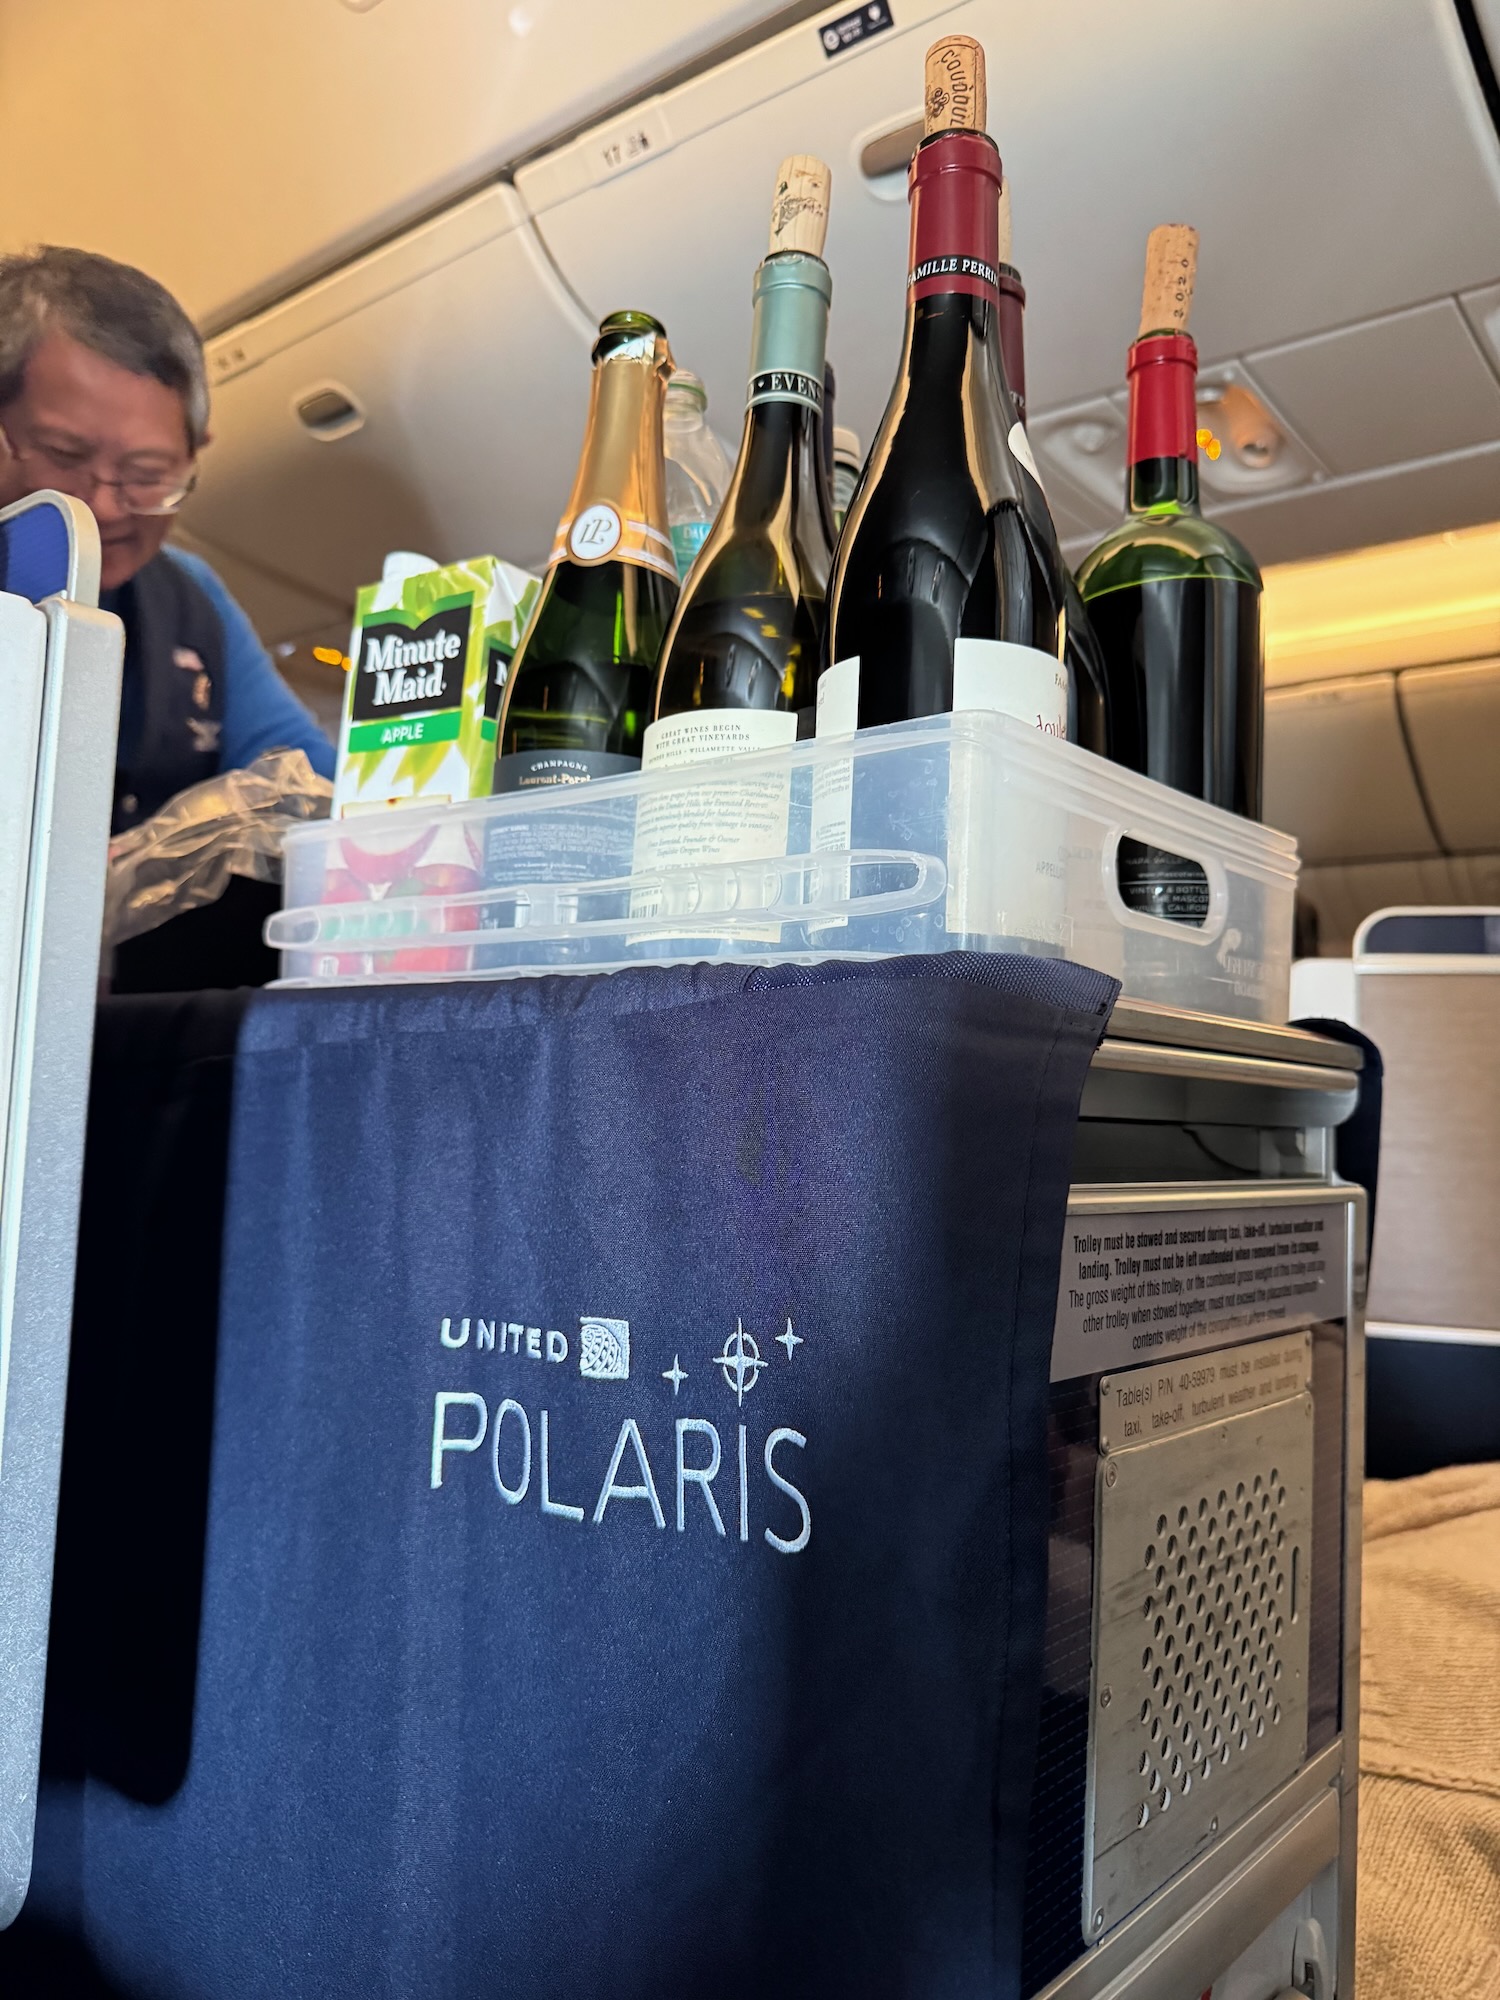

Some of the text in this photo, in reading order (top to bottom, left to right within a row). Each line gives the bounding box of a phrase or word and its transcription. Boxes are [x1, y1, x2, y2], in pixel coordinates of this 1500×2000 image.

[364, 629, 461, 673] Minute
[381, 722, 424, 744] APPLE
[656, 733, 751, 750] WITH GREAT VINEYARDS
[661, 724, 741, 740] GREAT WINES BEGIN
[530, 759, 588, 773] CHAMPAGNE
[1074, 1234, 1101, 1255] Trolley
[1104, 1232, 1123, 1251] must
[1125, 1231, 1135, 1249] be
[1137, 1228, 1163, 1248] stowed
[1165, 1228, 1178, 1245] and
[1179, 1225, 1205, 1244] secured
[1207, 1226, 1227, 1243] during
[1079, 1260, 1112, 1281] landing.
[1115, 1256, 1141, 1277] Trolley
[1143, 1254, 1161, 1272] must
[1163, 1252, 1174, 1270] not
[1176, 1251, 1184, 1268] be
[1186, 1250, 1197, 1267] left
[1069, 1289, 1084, 1308] The
[1086, 1288, 1109, 1309] gross
[1111, 1283, 1136, 1304] weight
[1137, 1280, 1146, 1298] of
[1147, 1279, 1160, 1297] this
[1162, 1277, 1184, 1296] trolley,
[1186, 1278, 1193, 1291] or
[1083, 1314, 1104, 1333] other
[1106, 1310, 1130, 1330] trolley
[1131, 1306, 1151, 1324] when
[1153, 1301, 1178, 1321] stowed
[440, 1318, 569, 1364] UNITED
[1133, 1329, 1163, 1350] contents
[1165, 1324, 1187, 1344] weight
[1189, 1321, 1197, 1338] of
[1116, 1382, 1152, 1408] Table(s)
[1158, 1377, 1174, 1397] P/N
[1124, 1415, 1142, 1437] taxi,
[430, 1391, 812, 1554] POLARIS
